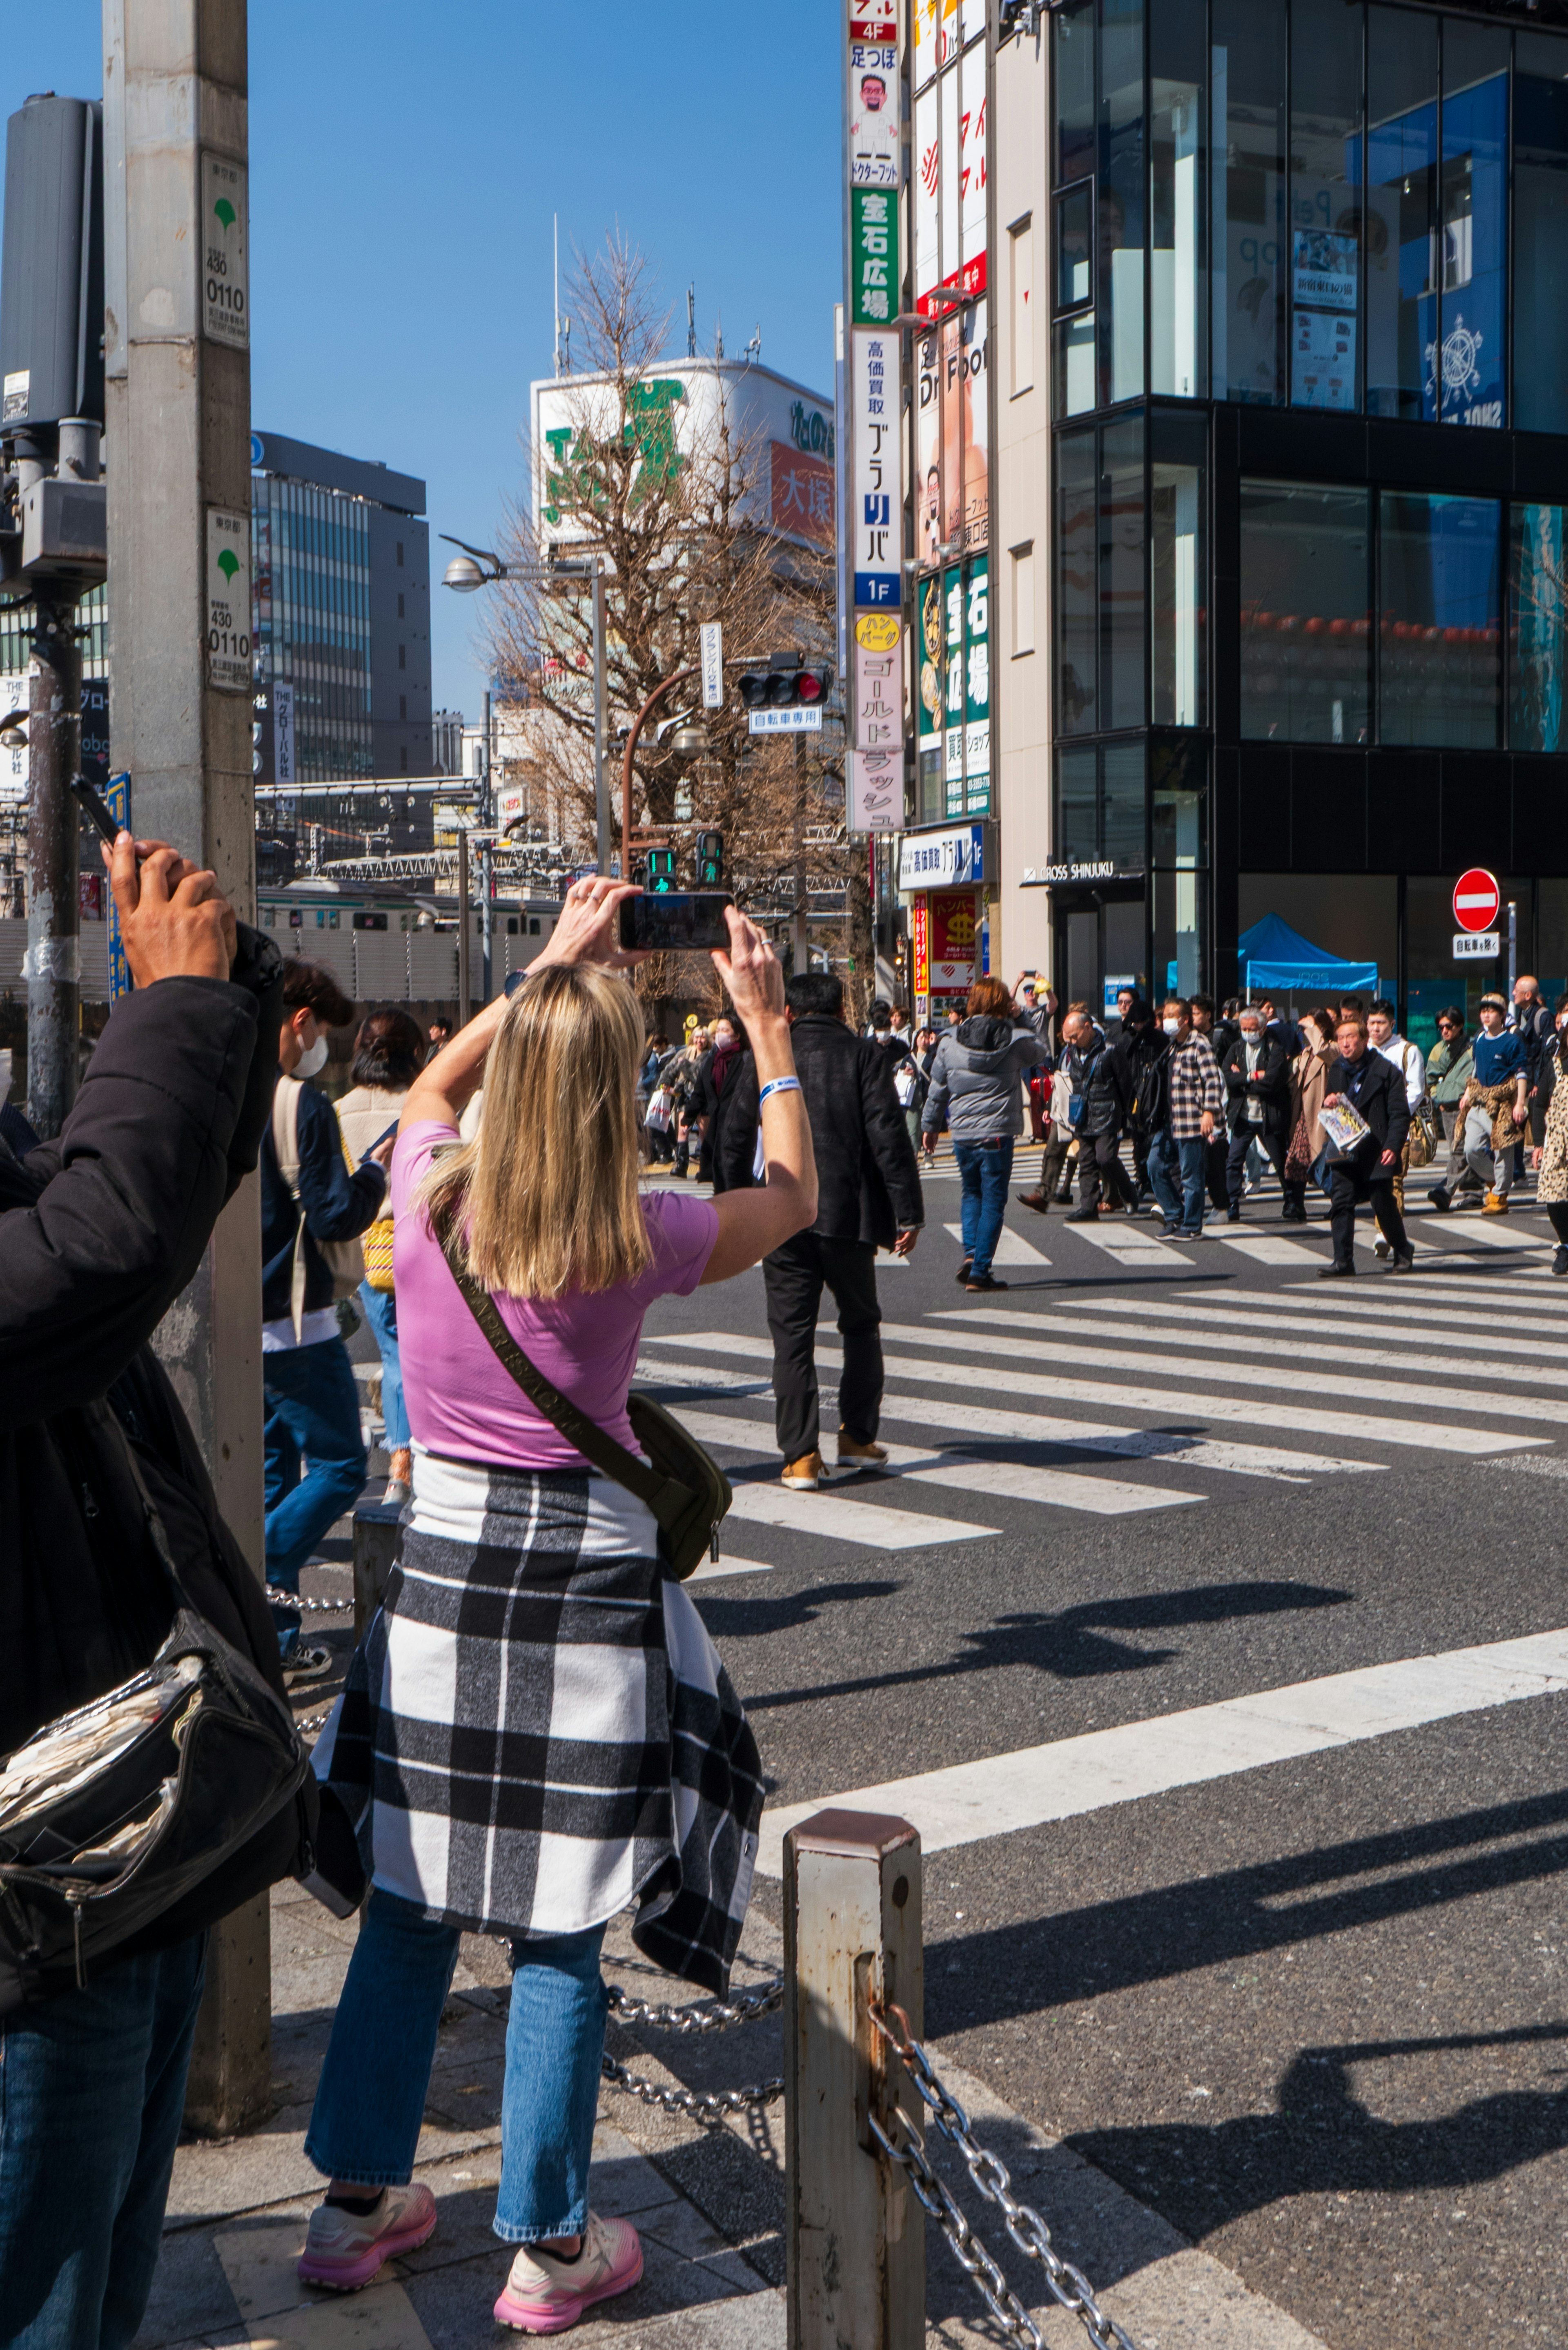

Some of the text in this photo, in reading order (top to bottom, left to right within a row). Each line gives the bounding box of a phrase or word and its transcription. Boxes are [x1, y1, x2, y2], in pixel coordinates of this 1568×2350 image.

[863, 22, 884, 40] 4F
[851, 45, 895, 70] 足つぼ
[852, 163, 897, 183] ドクターフット
[207, 255, 227, 276] 430
[862, 193, 889, 320] 宝石広場
[207, 278, 244, 312] 0110
[868, 341, 884, 415] 高価買取
[782, 468, 831, 523] 大塚
[864, 423, 889, 562] ブラリバ
[868, 579, 890, 601] 1F
[212, 610, 232, 628] 430
[210, 629, 249, 658] 0110
[7, 681, 24, 693] THE
[275, 691, 291, 703] THE
[755, 710, 816, 727] 自転車専用
[914, 846, 940, 875] 高価買取
[973, 840, 982, 866] 1F
[1040, 861, 1114, 882] CROSS SHINJUKU
[1457, 938, 1497, 953] 自転車を除く
